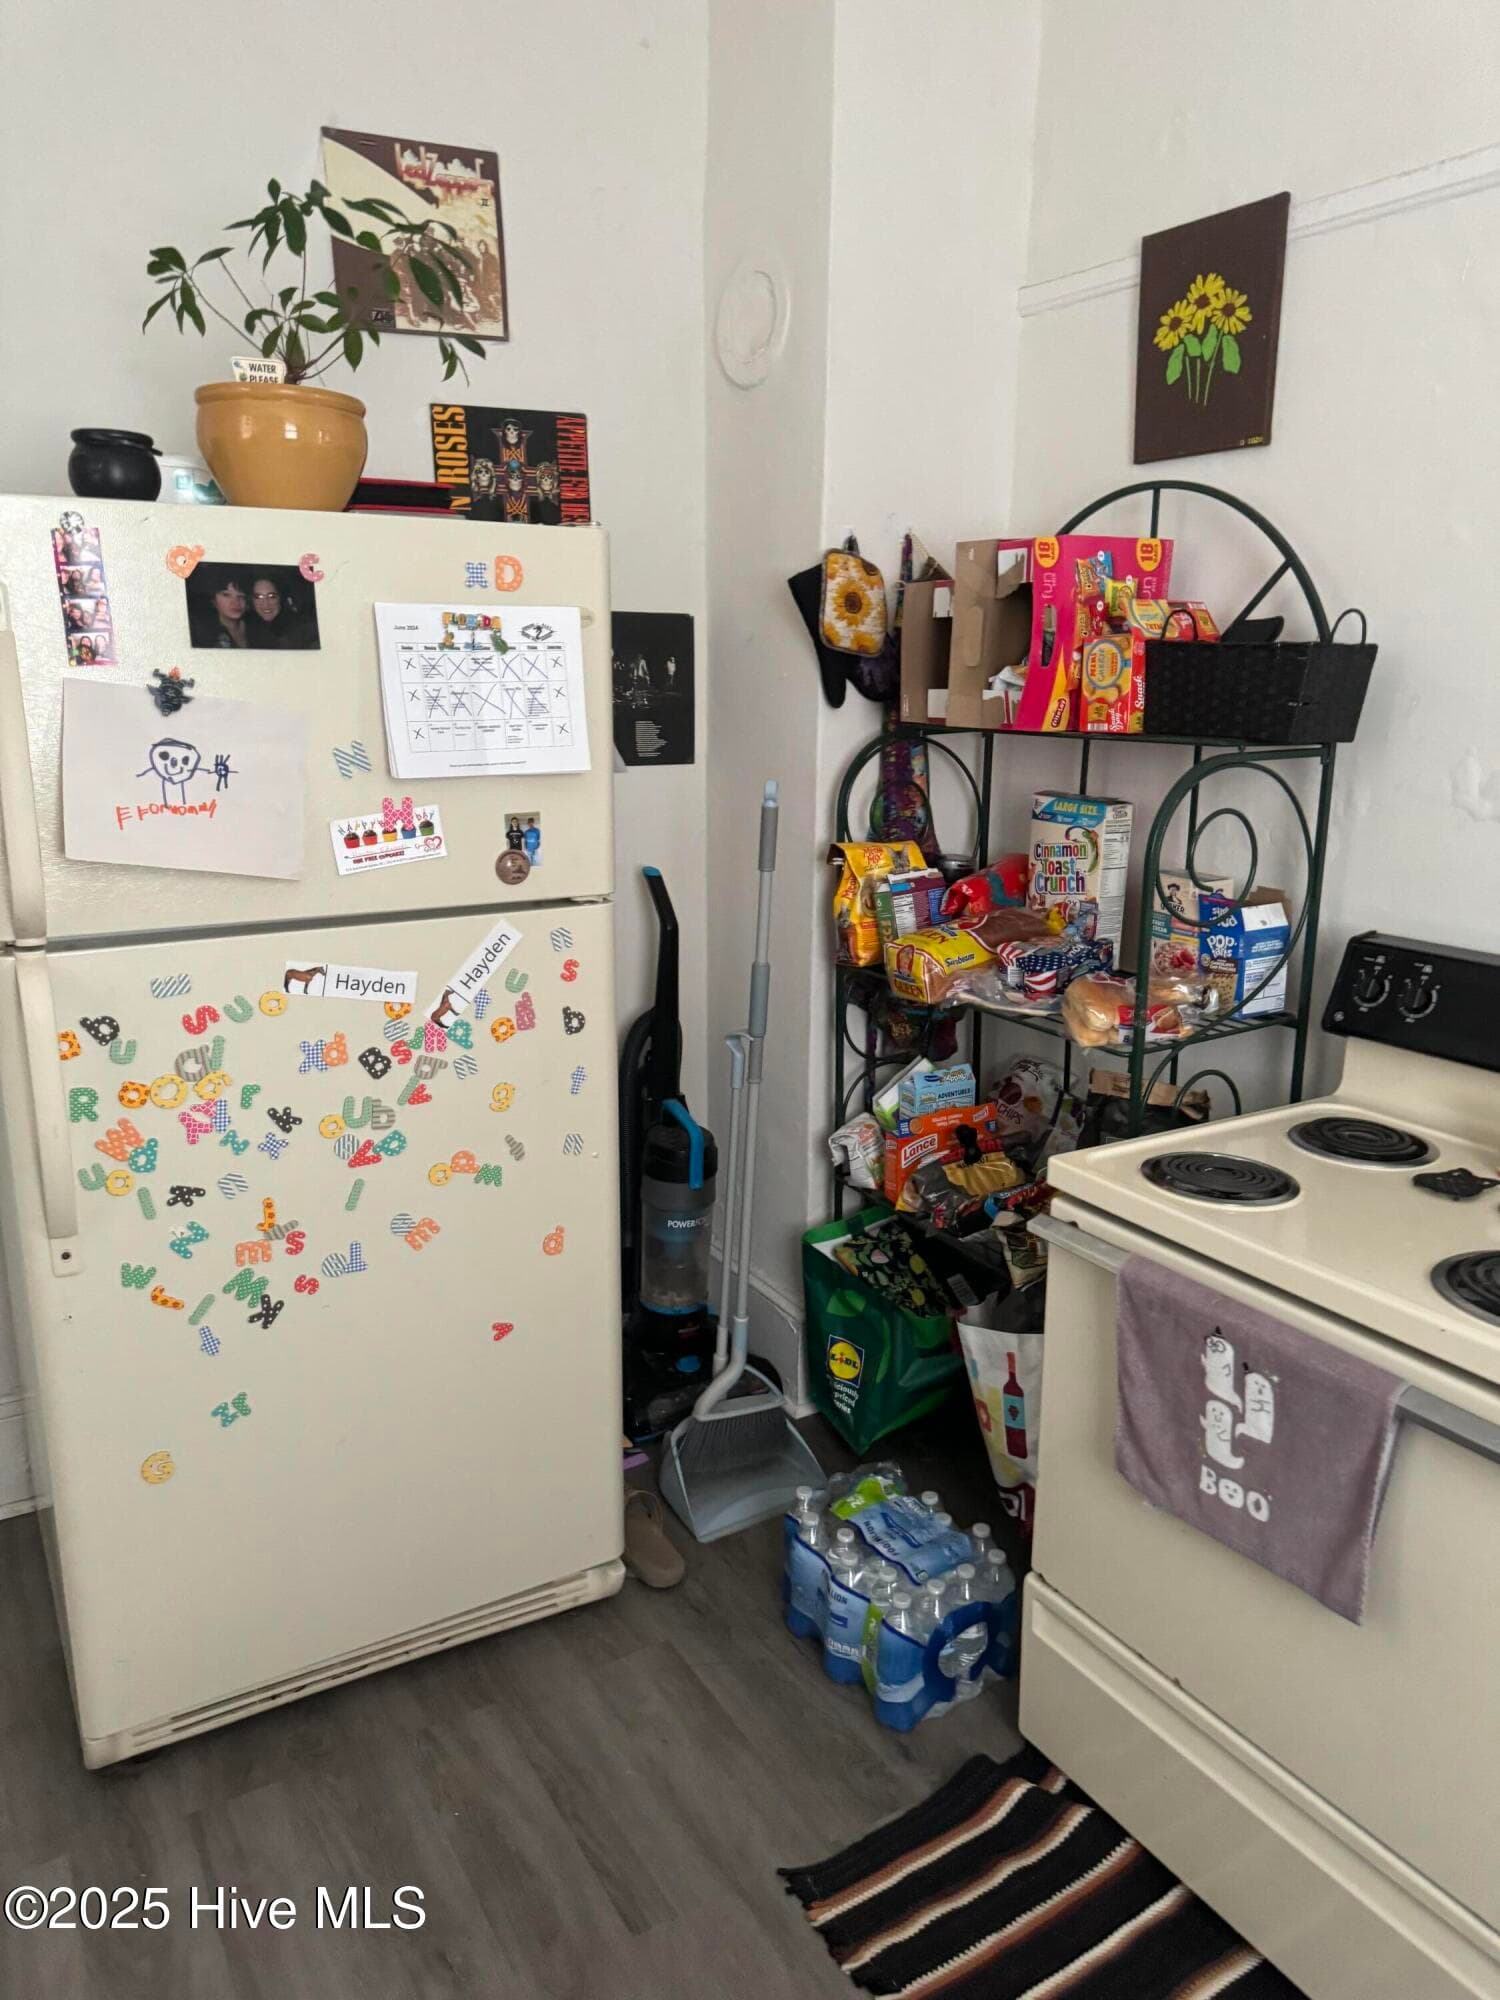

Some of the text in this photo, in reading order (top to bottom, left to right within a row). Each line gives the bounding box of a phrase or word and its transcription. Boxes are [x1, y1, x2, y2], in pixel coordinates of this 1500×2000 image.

[248, 363, 277, 374] WATER
[249, 374, 279, 384] PLEASE
[432, 405, 471, 484] ROSES
[1037, 541, 1051, 560] 18
[1140, 543, 1154, 564] 18
[1035, 842, 1088, 859] Cinnamon
[1041, 858, 1077, 876] Toast
[1035, 870, 1086, 893] Crunch
[459, 932, 511, 991] Hayden
[944, 953, 976, 967] Sunbeam
[335, 973, 406, 996] Hayden
[563, 1006, 586, 1036] b
[357, 1046, 392, 1080] B
[69, 1086, 99, 1123] R
[903, 1136, 937, 1162] Lance
[285, 1230, 306, 1256] s
[1200, 1464, 1270, 1522] BOO
